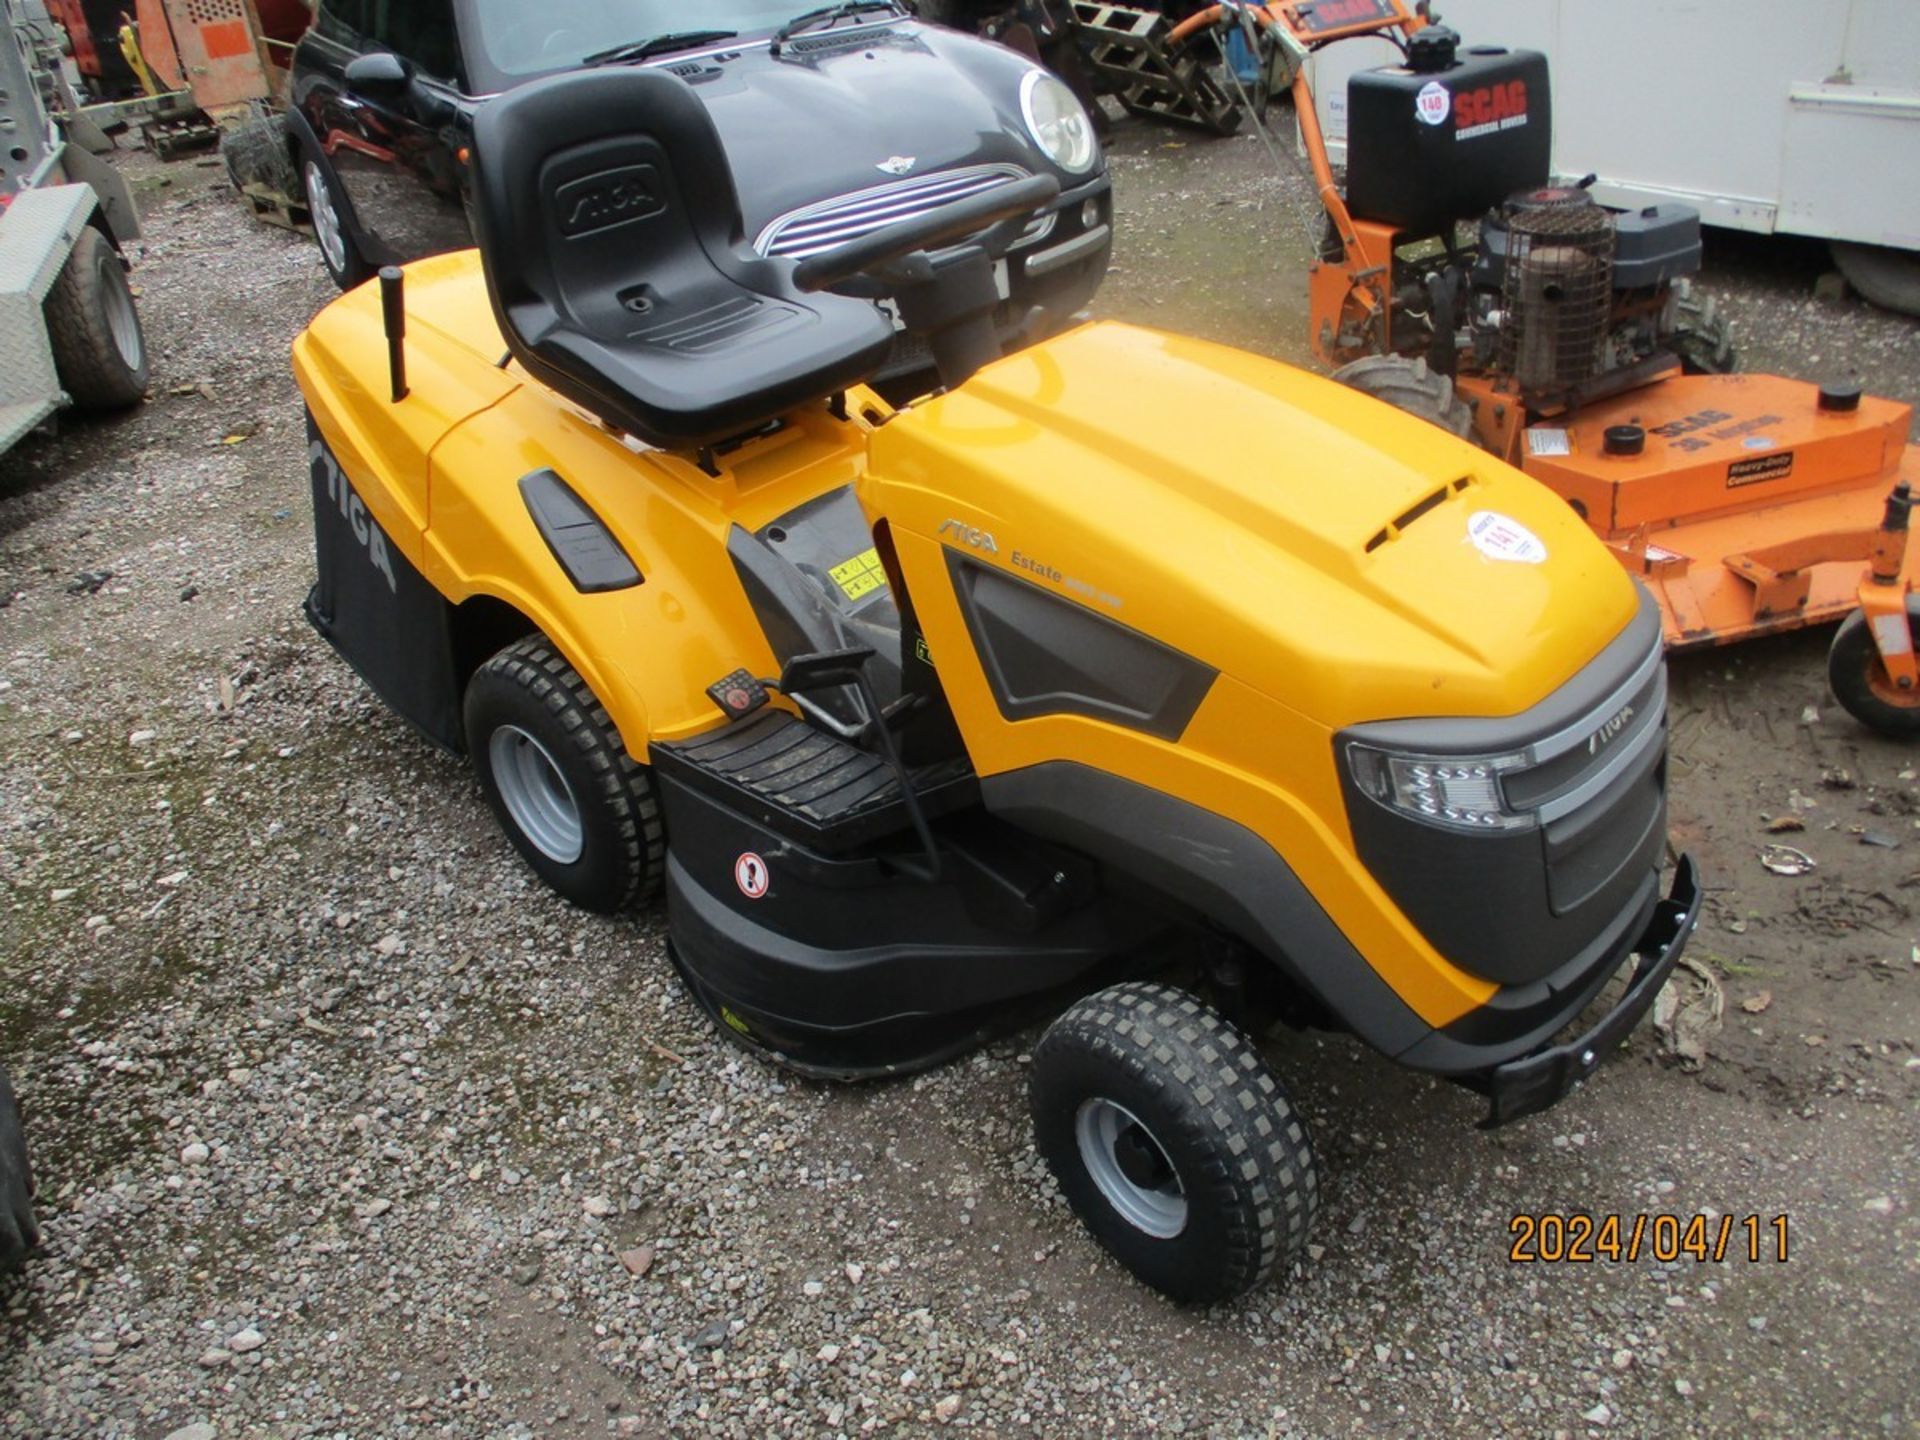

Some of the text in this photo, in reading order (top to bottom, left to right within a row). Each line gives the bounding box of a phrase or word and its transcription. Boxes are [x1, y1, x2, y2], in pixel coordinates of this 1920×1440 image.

[1421, 95, 1443, 111] 140
[1453, 79, 1528, 128] SCAG
[1649, 408, 1734, 439] SCAG
[1727, 465, 1791, 488] Commercial
[1730, 454, 1791, 475] Heavy-Duty
[939, 518, 1062, 583] STIGA Estate
